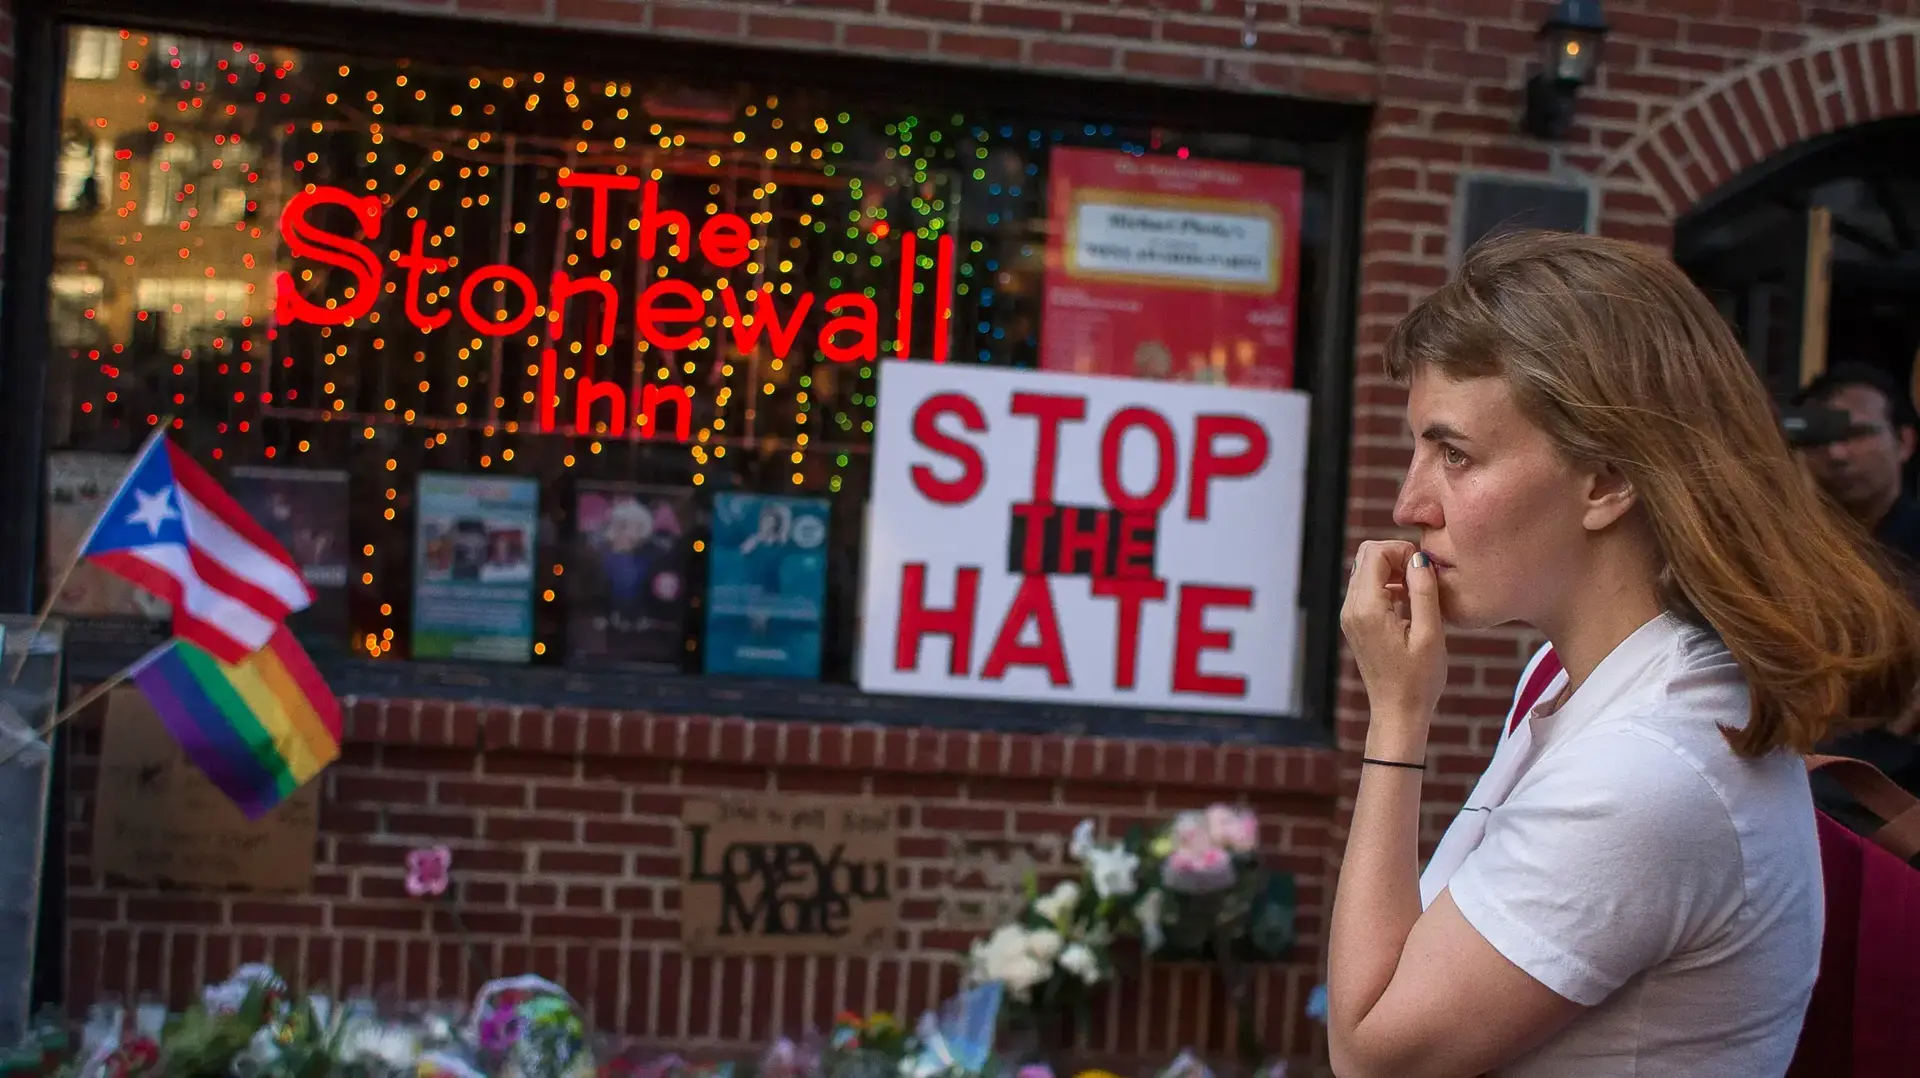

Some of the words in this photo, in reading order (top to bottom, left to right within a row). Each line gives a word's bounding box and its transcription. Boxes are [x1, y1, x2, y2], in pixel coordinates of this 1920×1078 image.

[558, 173, 752, 267] The
[275, 185, 953, 363] Stonewall
[540, 348, 693, 442] Inn
[908, 390, 1271, 521] STOP
[1010, 502, 1158, 580] THE
[893, 562, 1256, 699] HATE
[718, 876, 852, 934] More
